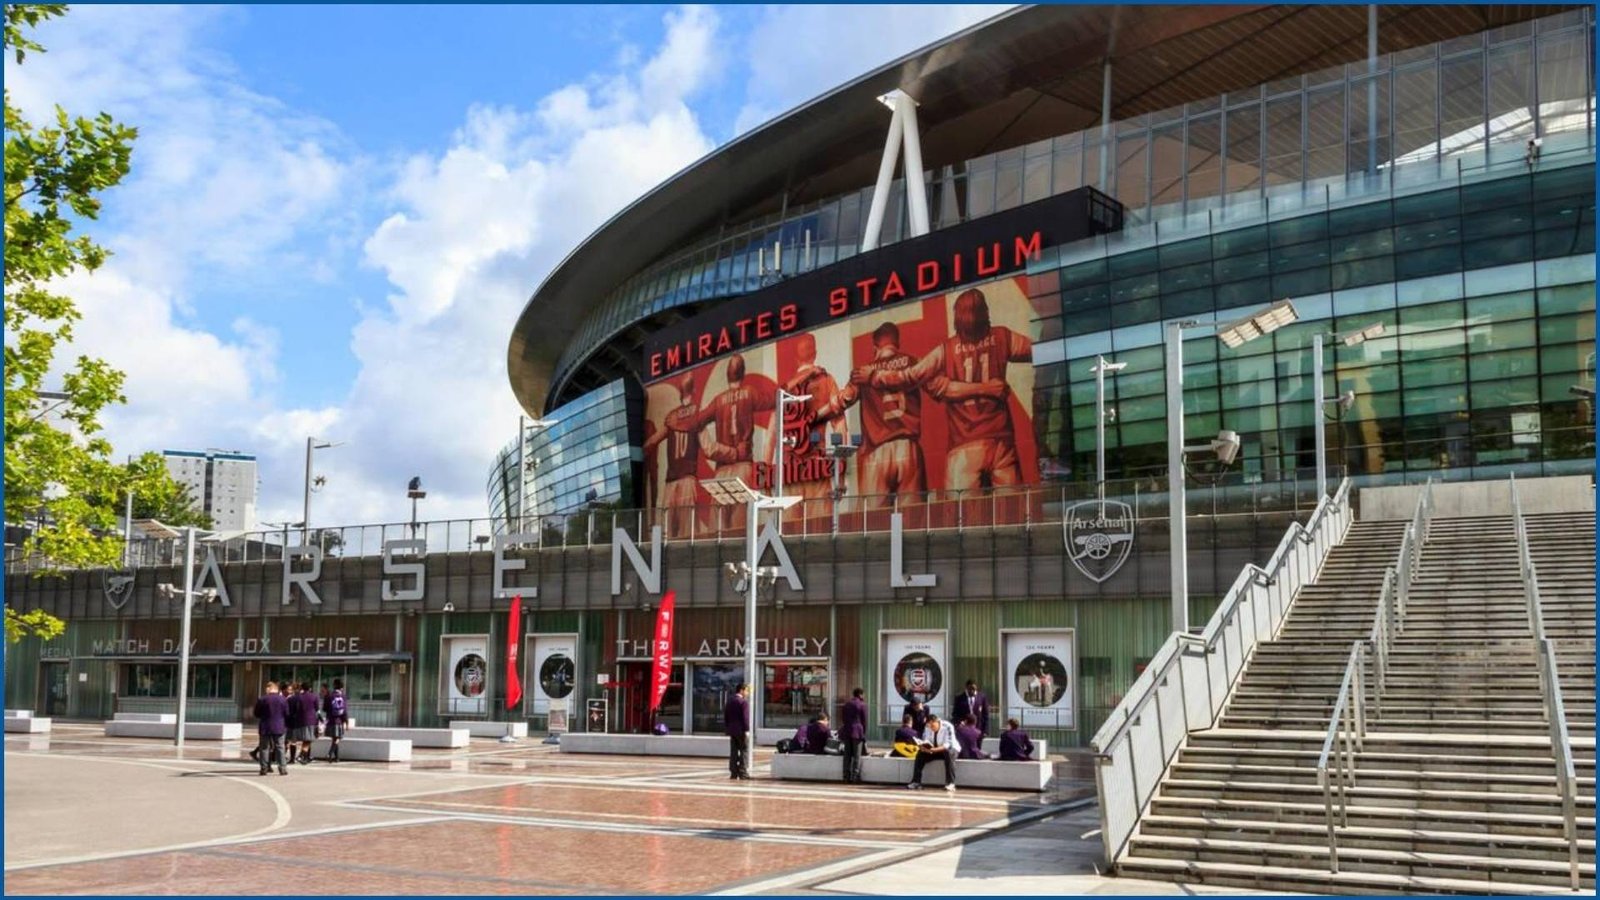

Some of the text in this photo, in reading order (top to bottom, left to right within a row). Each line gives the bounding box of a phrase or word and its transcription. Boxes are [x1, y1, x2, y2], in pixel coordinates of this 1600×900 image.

[650, 231, 1043, 377] EMIRATES STADIUM
[1073, 516, 1126, 530] Arsenal
[197, 512, 938, 607] ARSENAL
[92, 639, 149, 654] MATCH
[233, 638, 271, 654] BOX
[289, 637, 361, 653] OFFICE
[616, 637, 828, 656] TH ARMOURY
